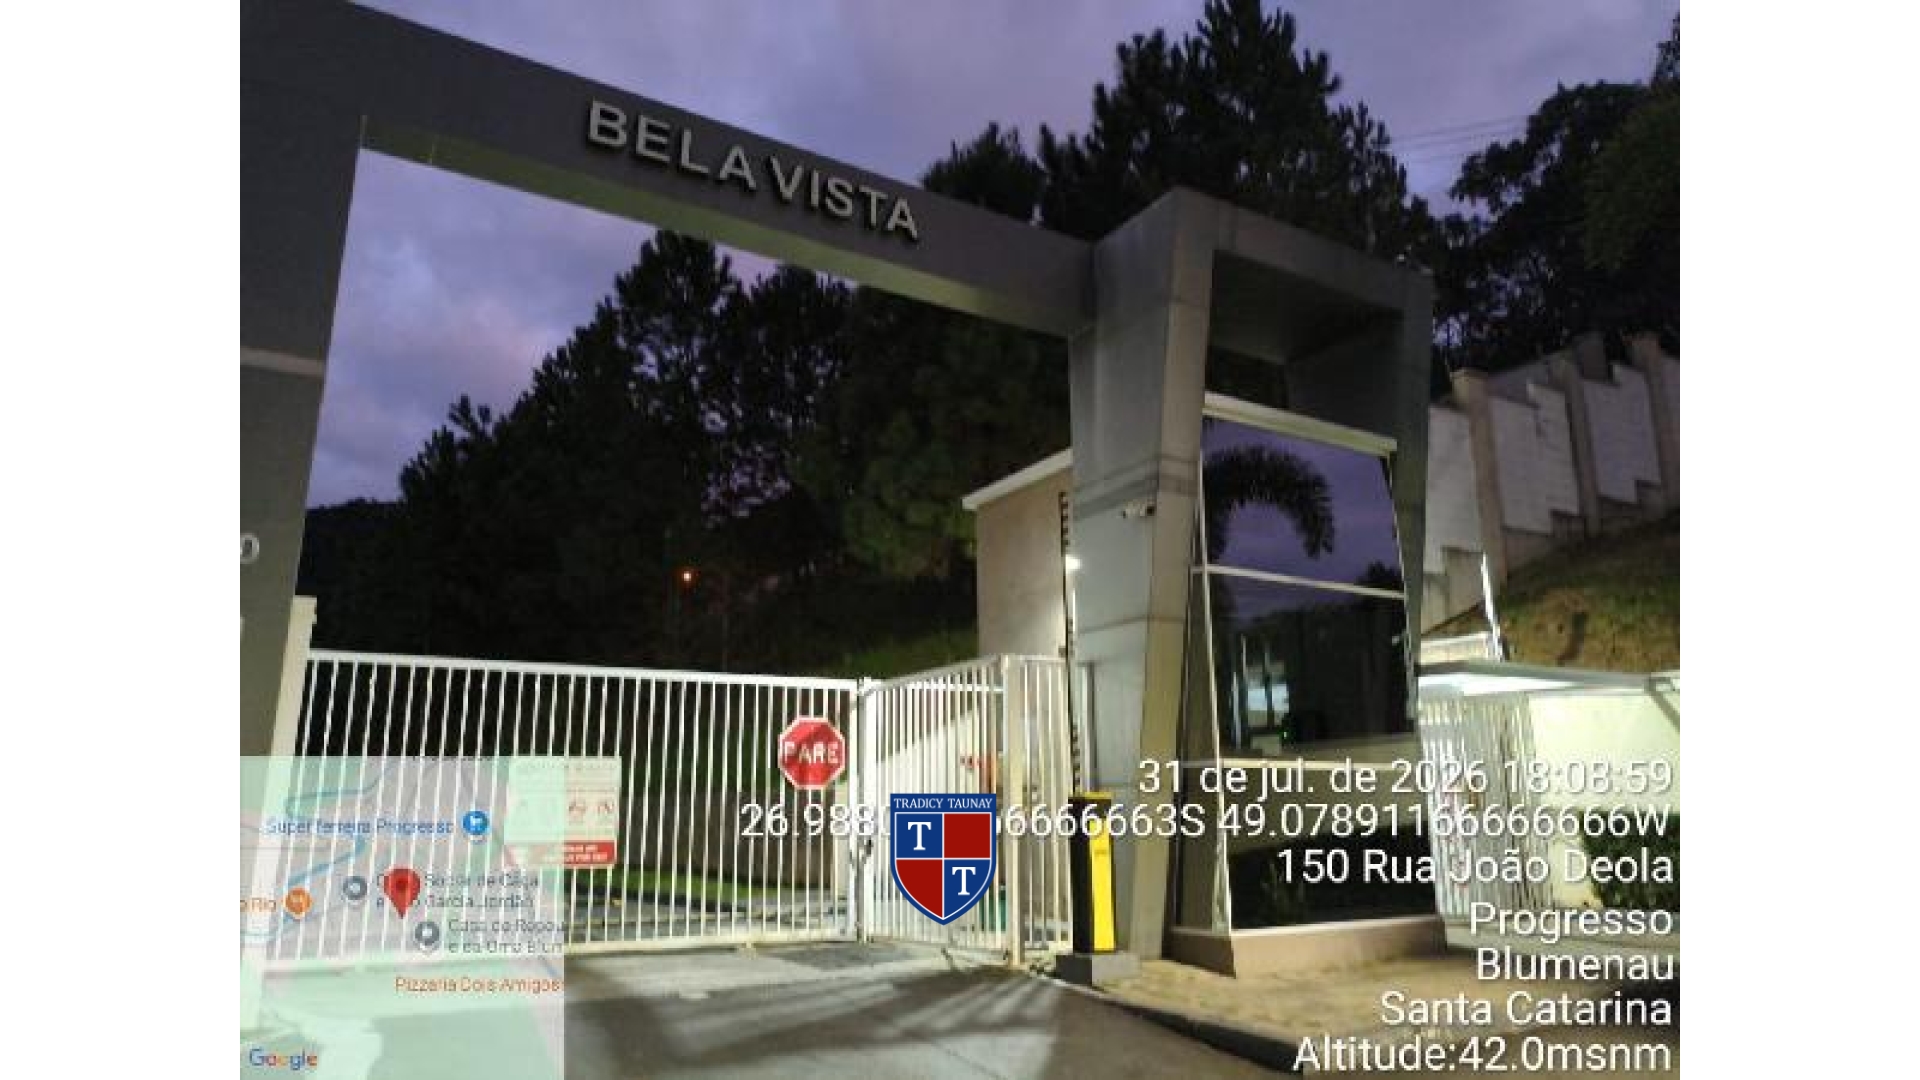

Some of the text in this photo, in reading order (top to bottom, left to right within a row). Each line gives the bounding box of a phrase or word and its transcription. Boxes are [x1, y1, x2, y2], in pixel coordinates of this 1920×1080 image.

[588, 99, 918, 241] BELA VISTA
[783, 741, 839, 765] PARE
